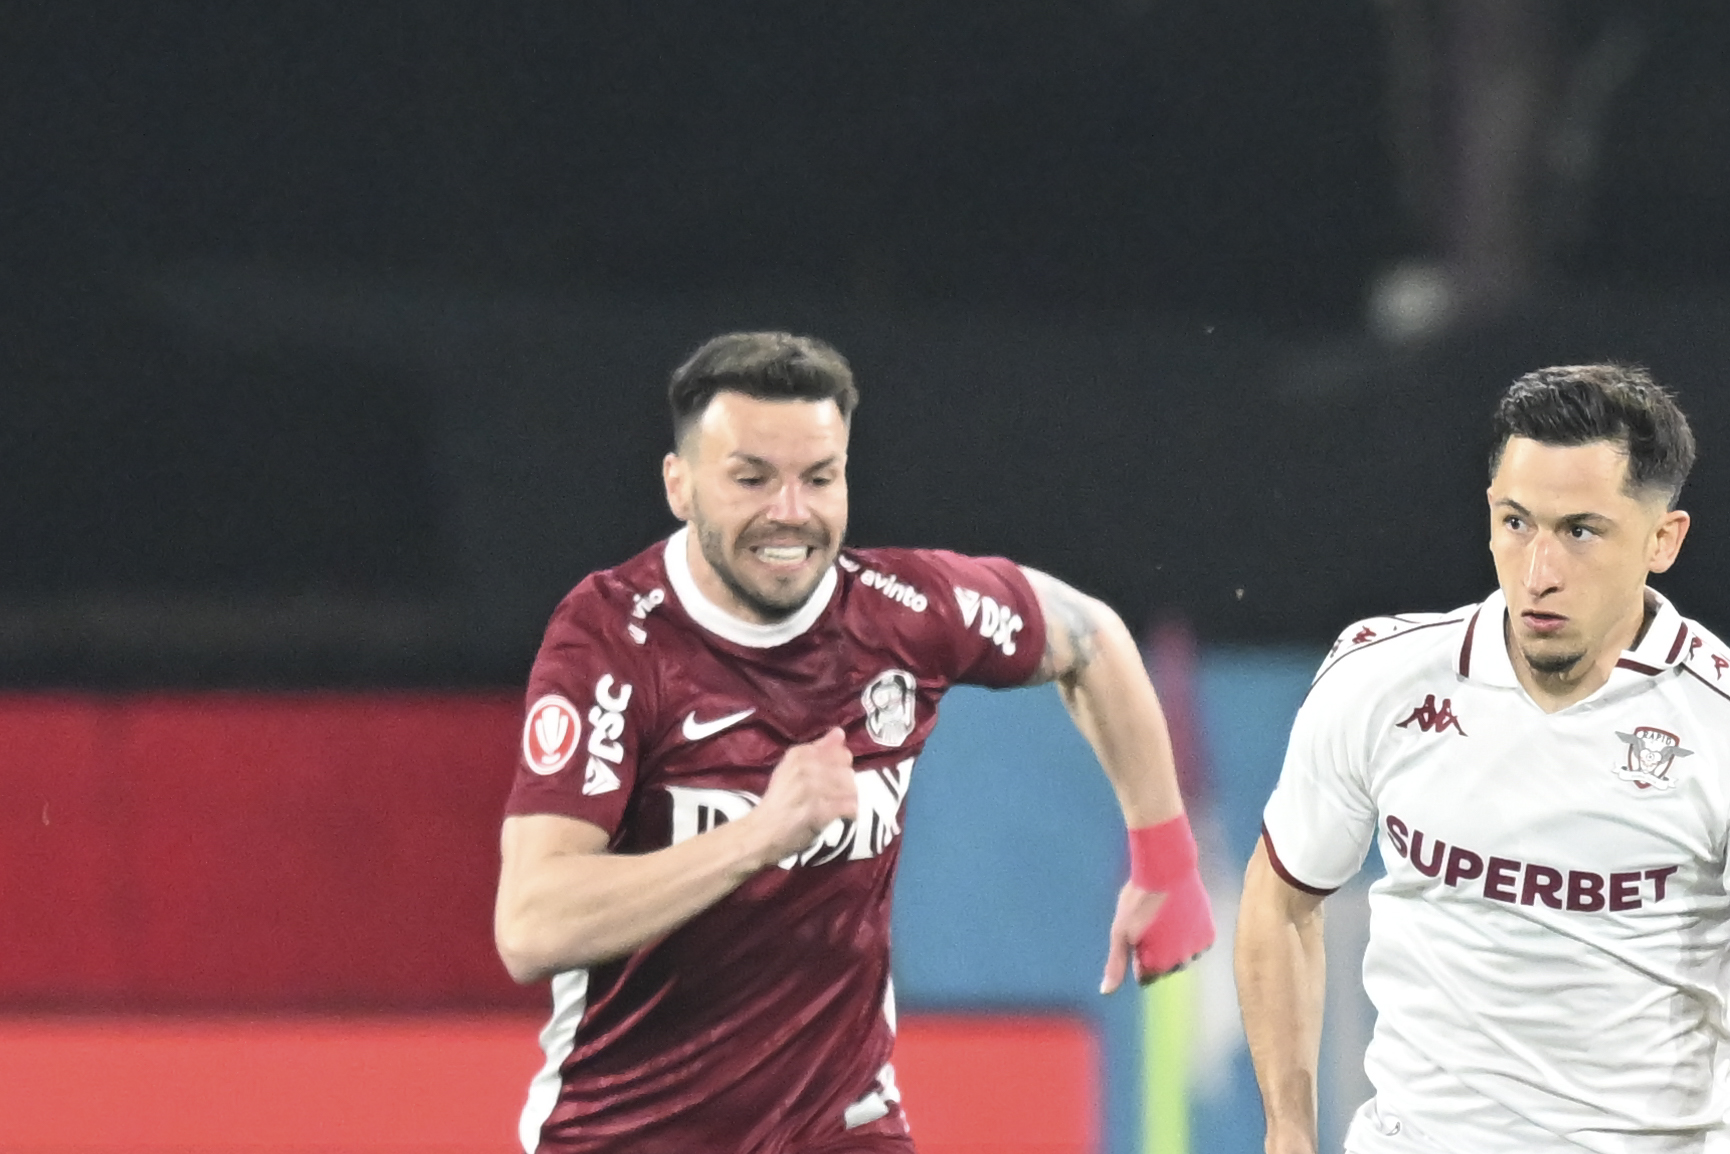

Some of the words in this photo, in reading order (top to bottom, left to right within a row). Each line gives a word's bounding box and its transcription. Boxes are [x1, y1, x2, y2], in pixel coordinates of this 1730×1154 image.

[860, 569, 928, 613] avinto
[1643, 731, 1673, 746] RAPID
[1386, 814, 1680, 913] SUPERBET
